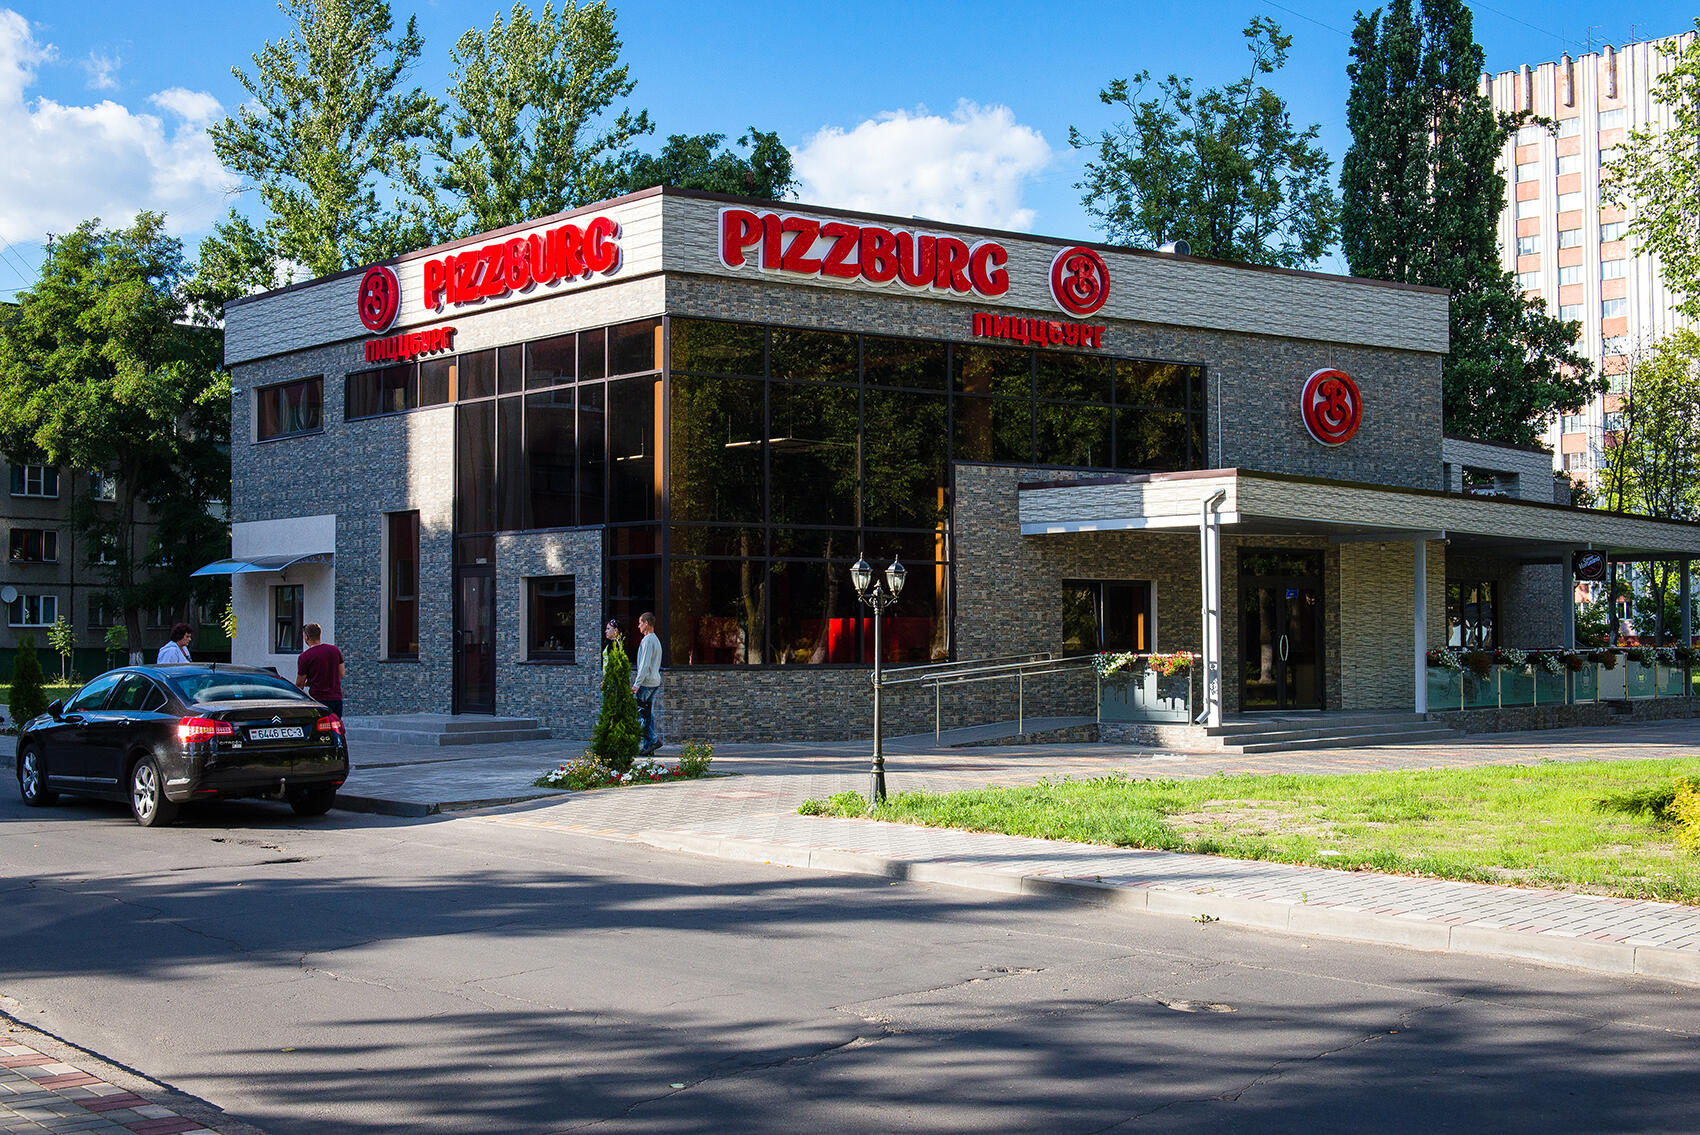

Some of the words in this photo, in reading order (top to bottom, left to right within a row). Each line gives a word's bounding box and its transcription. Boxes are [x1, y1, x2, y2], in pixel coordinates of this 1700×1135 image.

[424, 216, 622, 312] PIZZBURG
[722, 208, 1009, 297] PIZZBURG
[365, 326, 457, 362] ПИЦЦБУРГ
[972, 312, 1107, 348] ПИЦЦБУРГ
[258, 729, 279, 739] 6446
